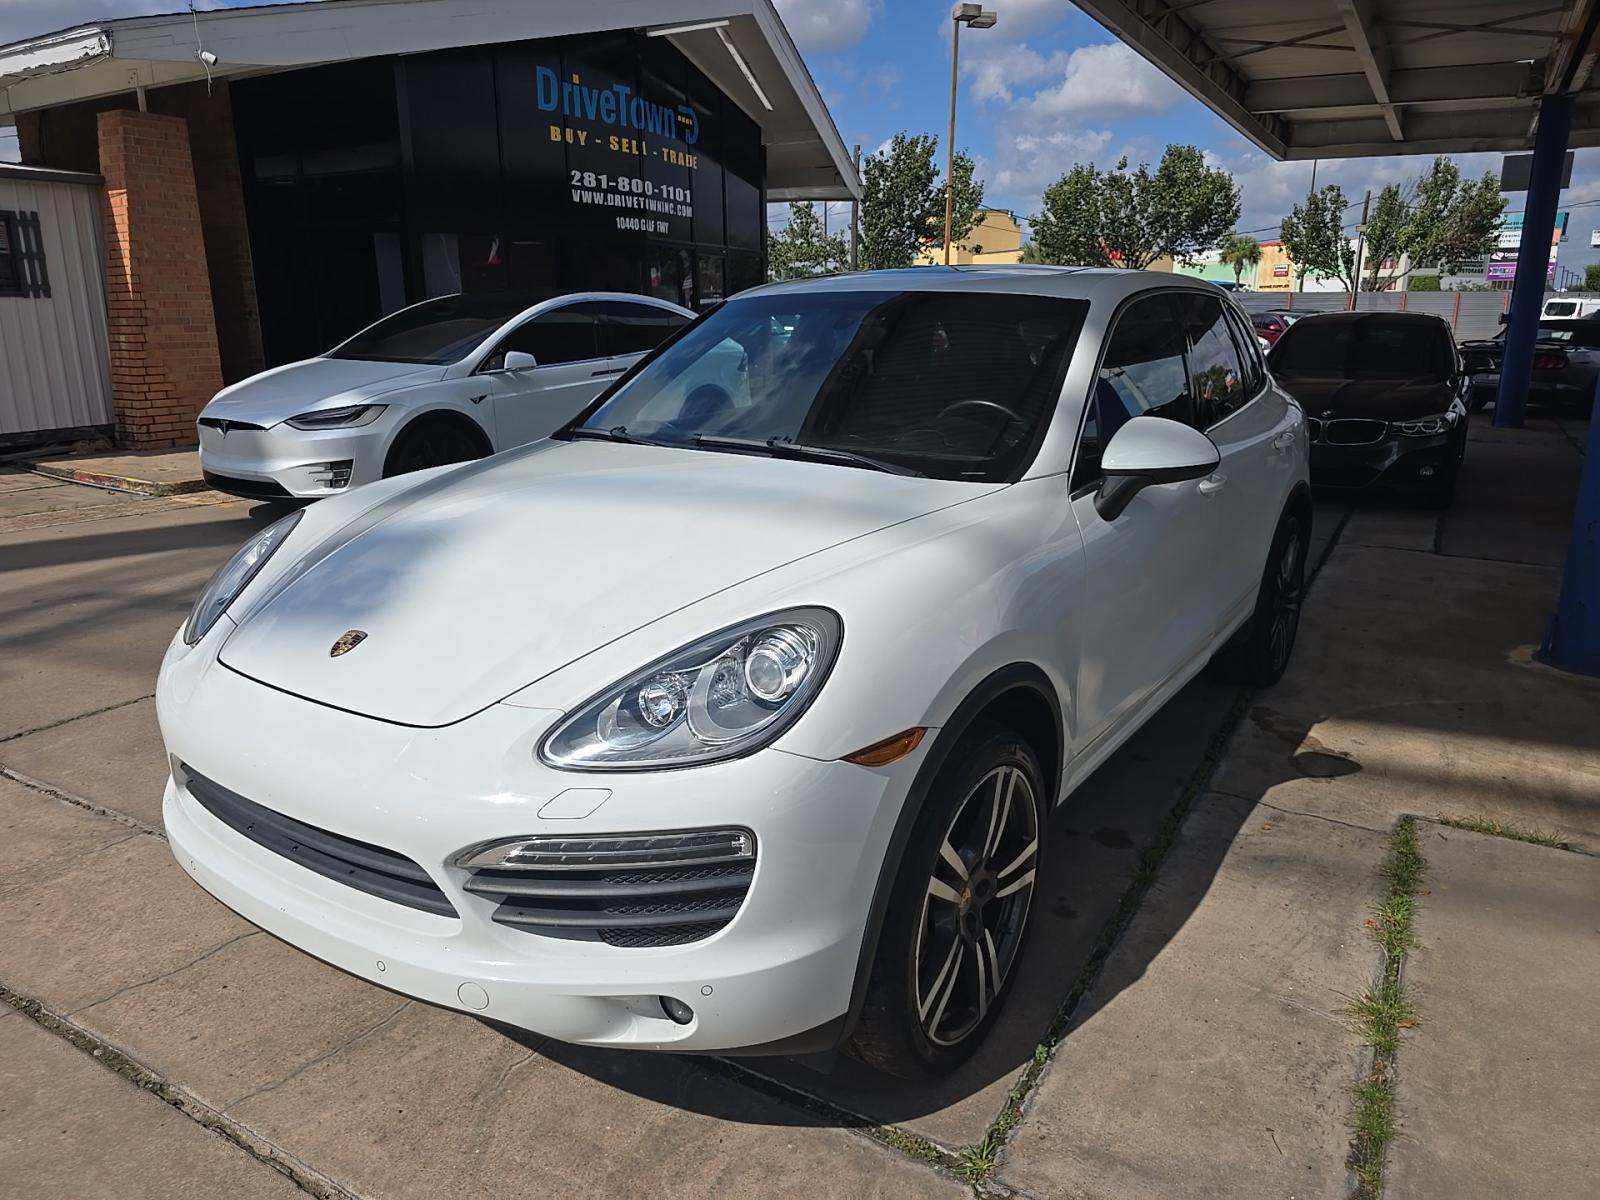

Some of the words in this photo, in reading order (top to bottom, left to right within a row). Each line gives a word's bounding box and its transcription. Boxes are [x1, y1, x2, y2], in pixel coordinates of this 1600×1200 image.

[535, 65, 675, 139] DriveTown
[550, 125, 587, 146] BUY
[662, 147, 698, 169] TRADE
[571, 169, 691, 203] 281-800-1101
[615, 216, 639, 231] 10440
[656, 221, 670, 234] FWY
